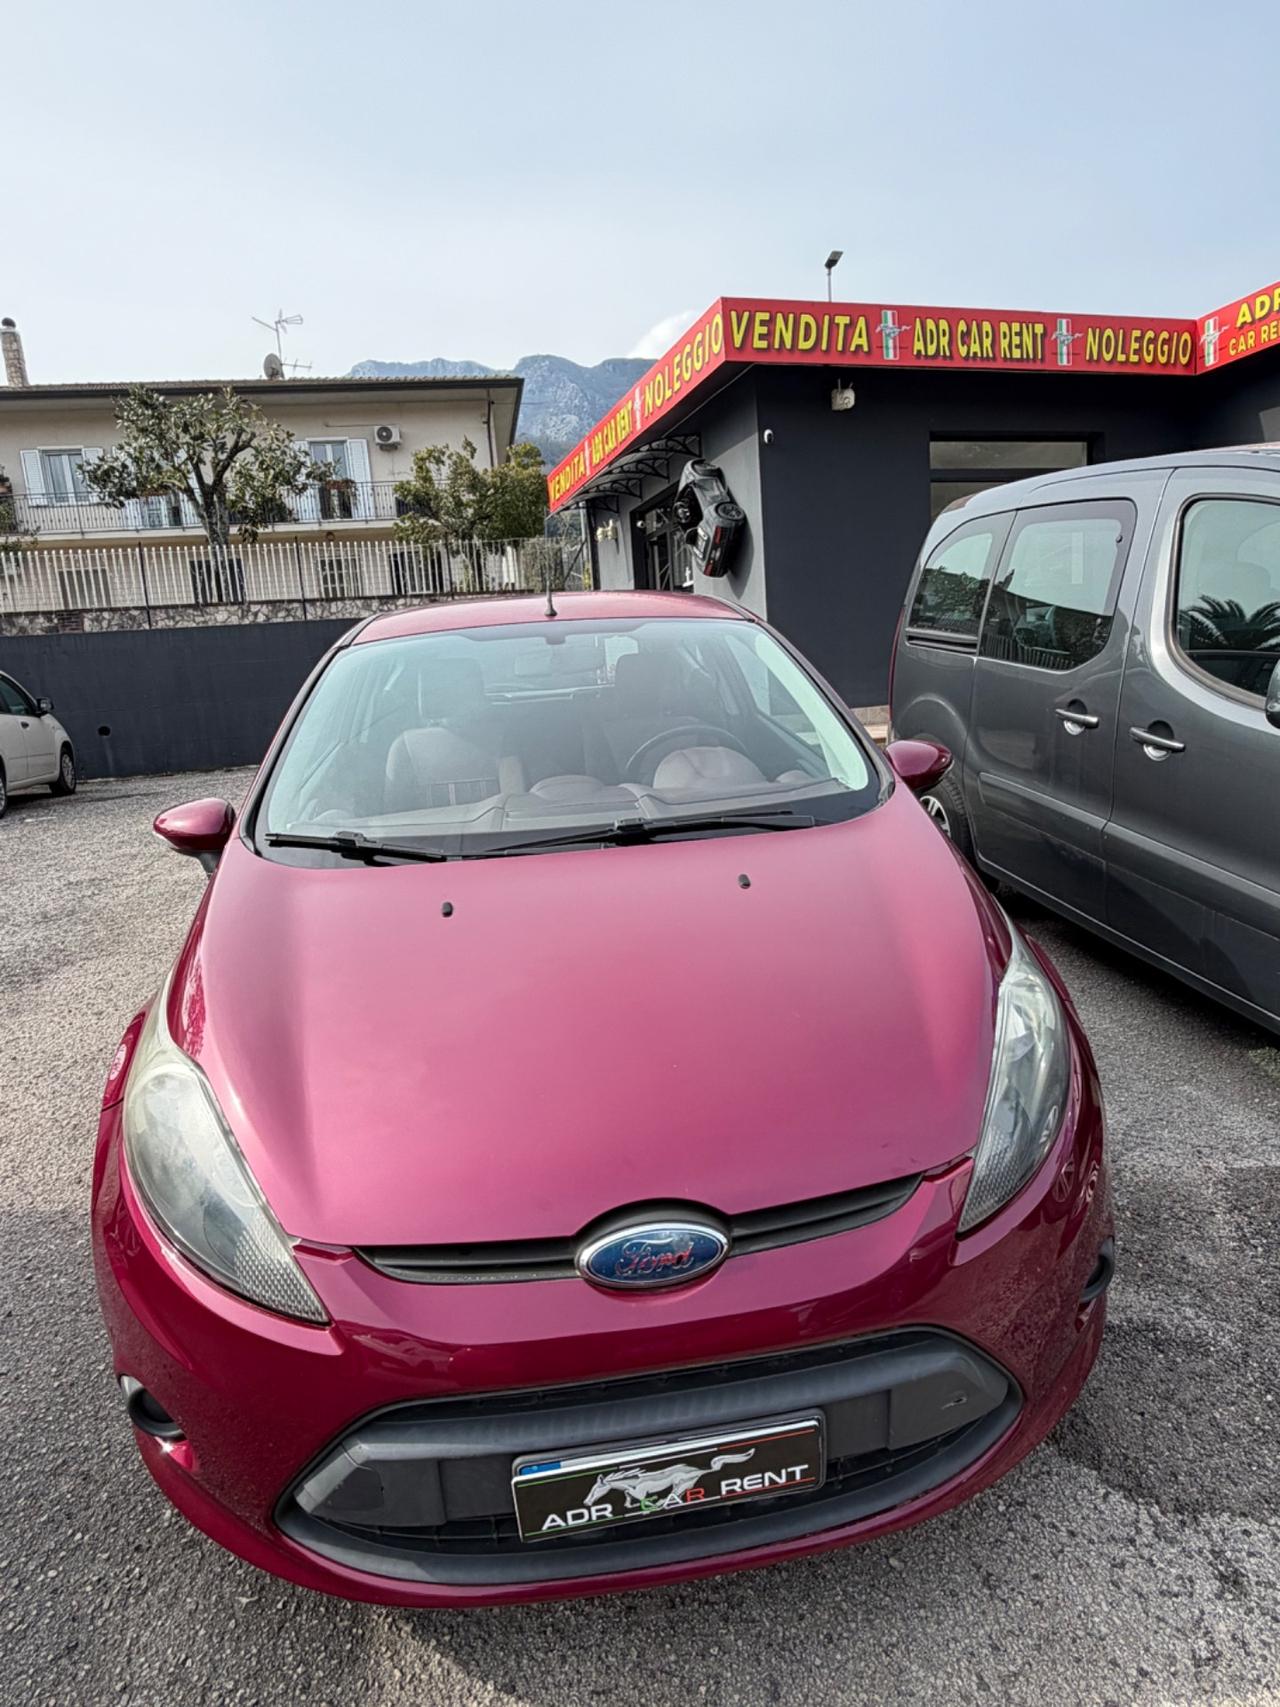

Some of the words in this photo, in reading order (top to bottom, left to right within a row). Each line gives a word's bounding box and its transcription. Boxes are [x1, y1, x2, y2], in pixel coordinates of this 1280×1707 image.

[730, 310, 869, 352] VENDITA
[913, 317, 950, 358] ADR
[957, 319, 993, 359] CAR
[1001, 322, 1045, 360] RENT
[1085, 326, 1191, 366] NOLEGGIO
[1229, 331, 1255, 356] CAR
[1261, 320, 1280, 344] RE
[550, 451, 585, 502] VENDITA
[644, 313, 722, 418] NOLEGGIO
[615, 1238, 695, 1277] Ford
[542, 1502, 614, 1531] ADR
[720, 1464, 809, 1496] RENT
